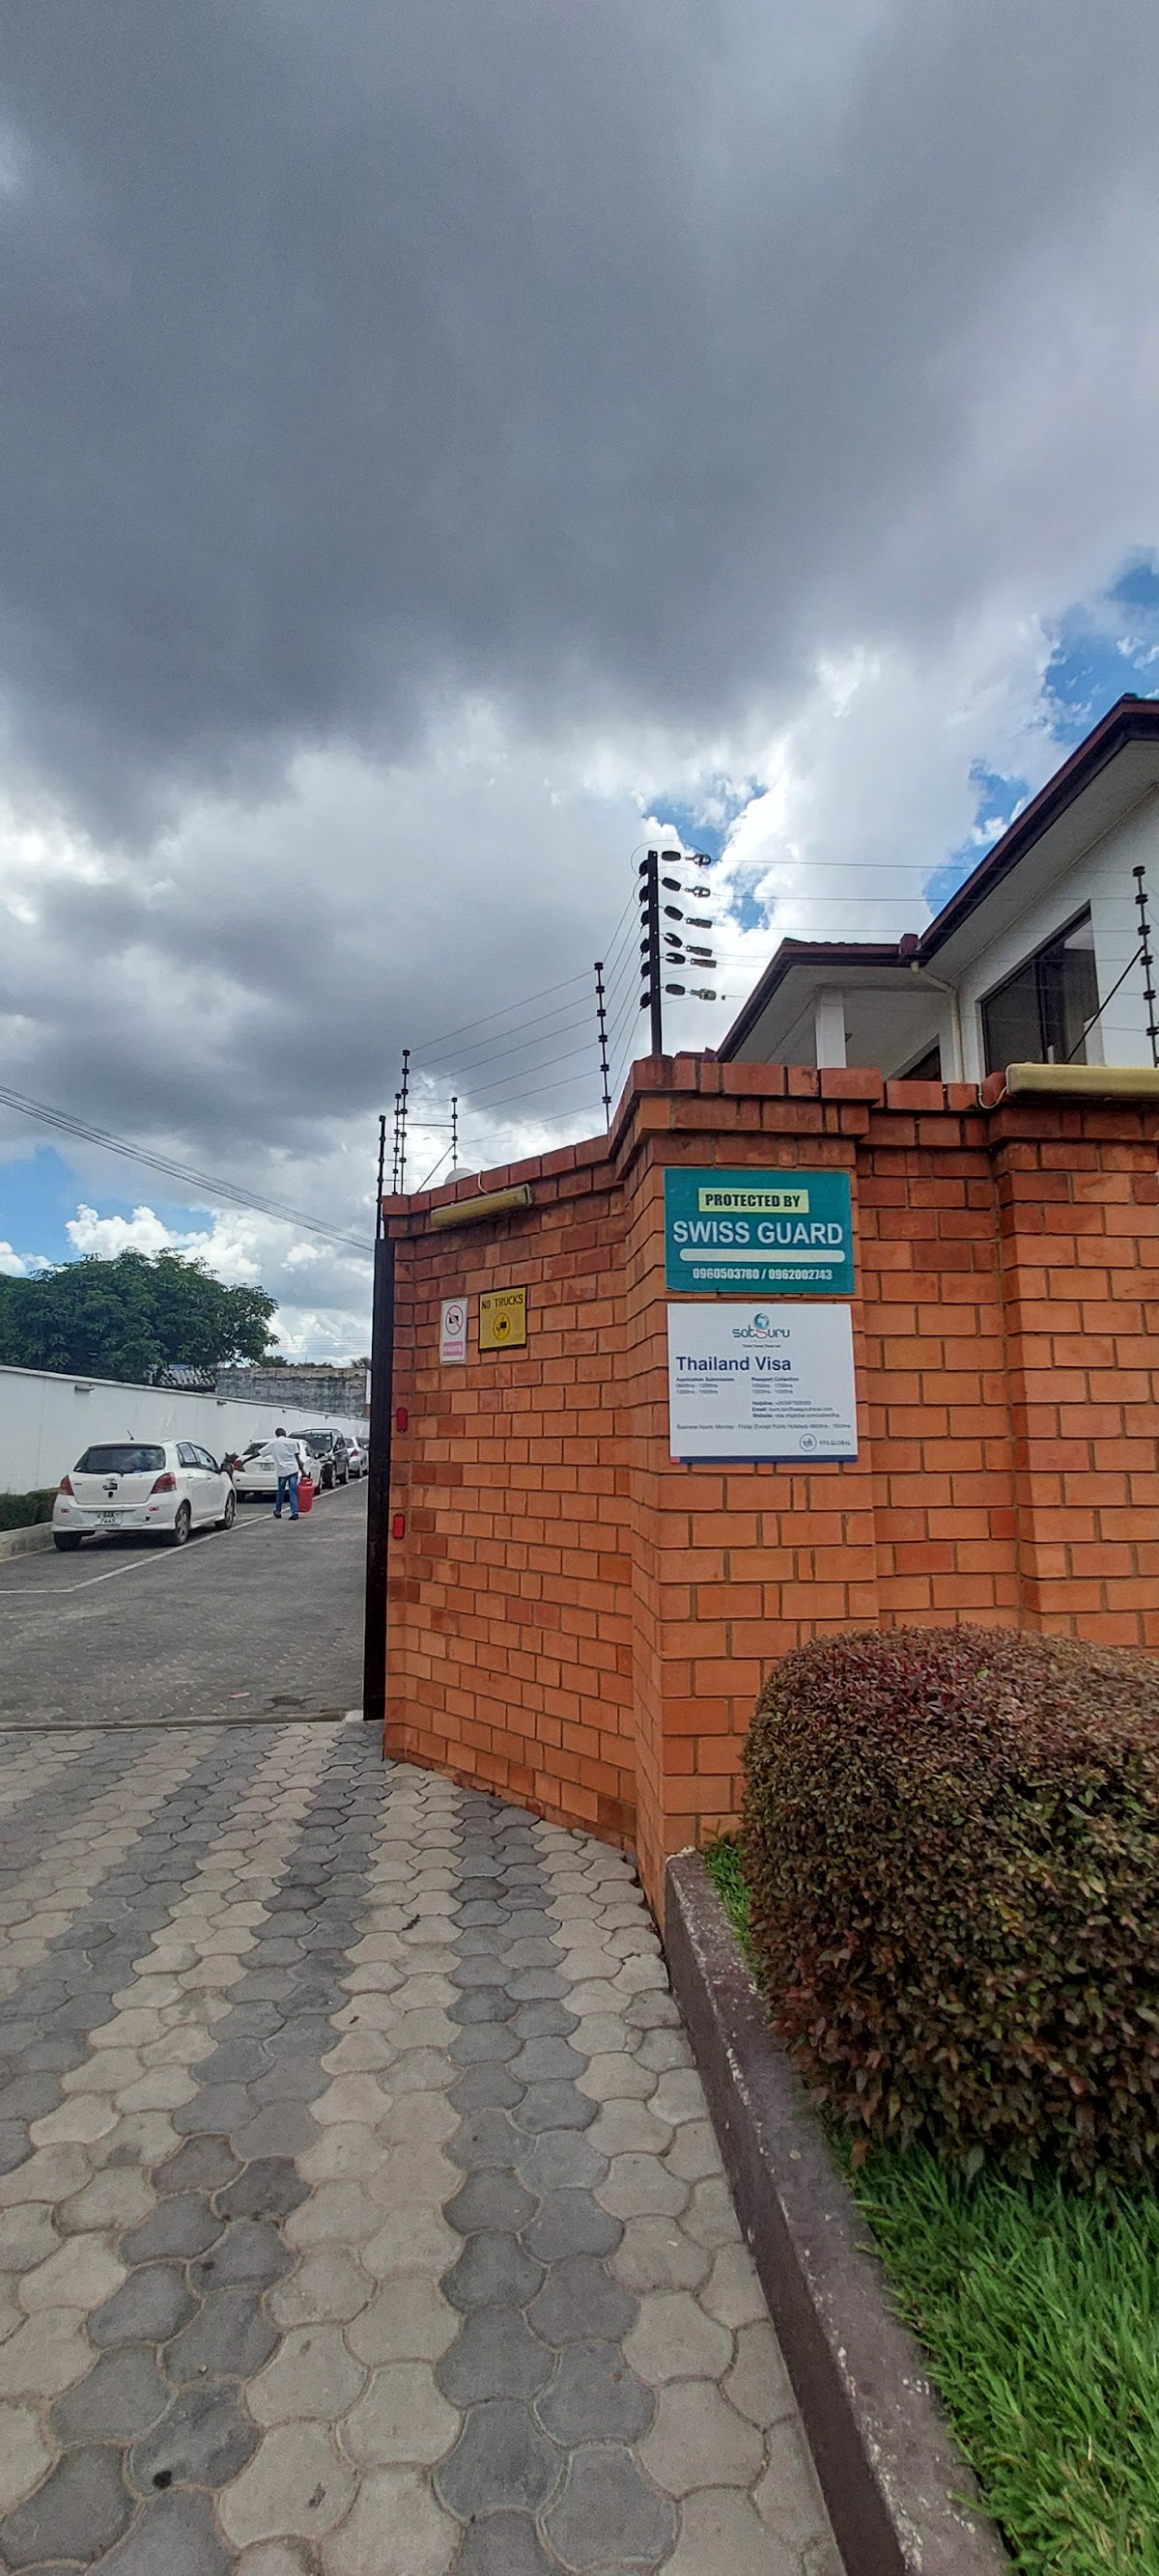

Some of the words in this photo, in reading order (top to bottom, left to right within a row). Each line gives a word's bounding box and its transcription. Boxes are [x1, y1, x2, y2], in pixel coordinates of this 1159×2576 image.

[705, 1193, 780, 1207] PROTECTED
[783, 1195, 801, 1208] BY
[673, 1220, 749, 1243] SWISS
[757, 1222, 842, 1245] GUARD
[761, 1269, 767, 1280] /
[768, 1269, 833, 1280] 0962002743
[481, 1300, 491, 1310] NO
[495, 1294, 523, 1308] TRUCKS
[676, 1356, 749, 1371] Thailand
[755, 1357, 791, 1371] Visa
